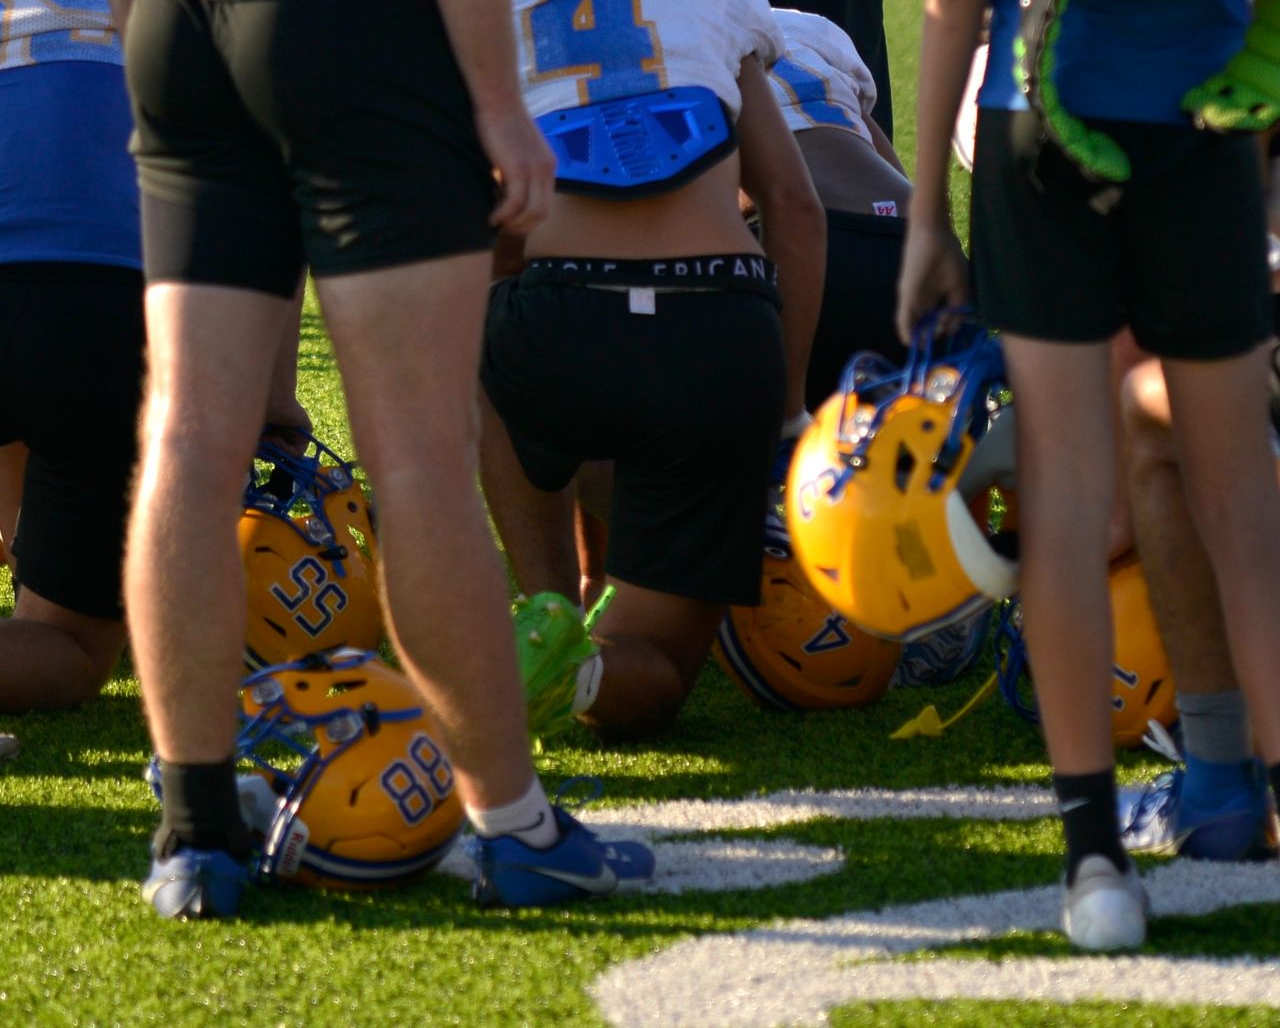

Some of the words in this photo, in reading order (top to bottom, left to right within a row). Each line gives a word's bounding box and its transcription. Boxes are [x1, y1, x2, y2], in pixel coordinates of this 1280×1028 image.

[270, 555, 348, 639] 55
[800, 610, 852, 655] 4
[379, 734, 455, 827] 88
